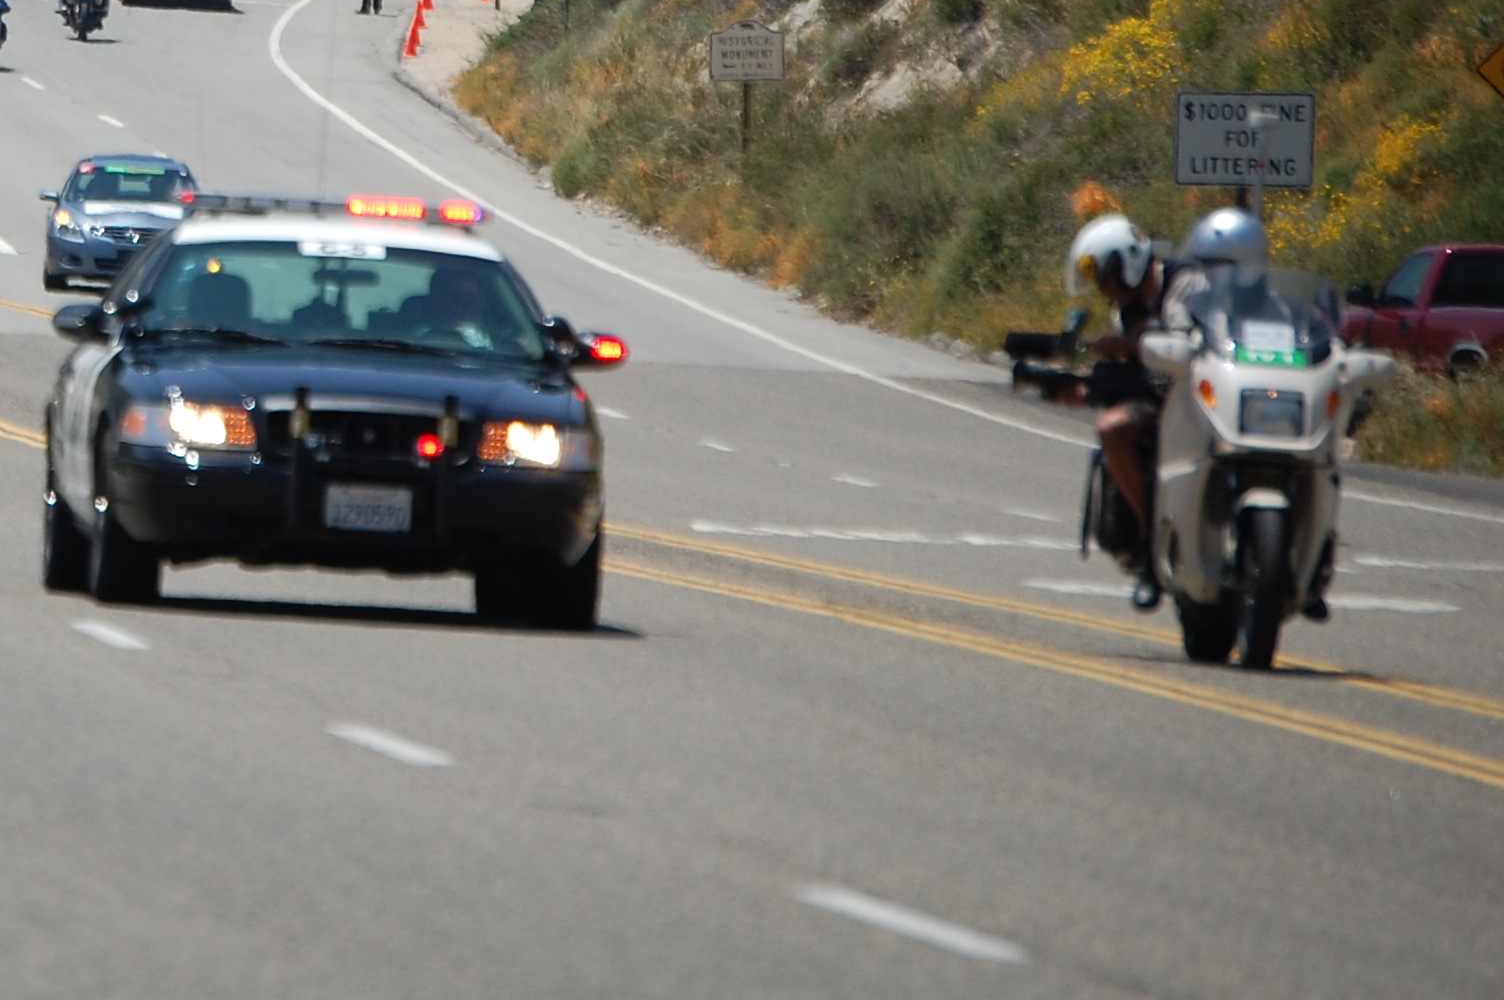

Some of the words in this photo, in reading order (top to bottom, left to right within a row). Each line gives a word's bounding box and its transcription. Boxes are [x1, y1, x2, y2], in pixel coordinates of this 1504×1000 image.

[718, 35, 776, 47] HISTORICAL
[721, 49, 774, 60] MONUMENT
[1184, 101, 1248, 122] $1000
[1191, 157, 1297, 176] LITTERNG
